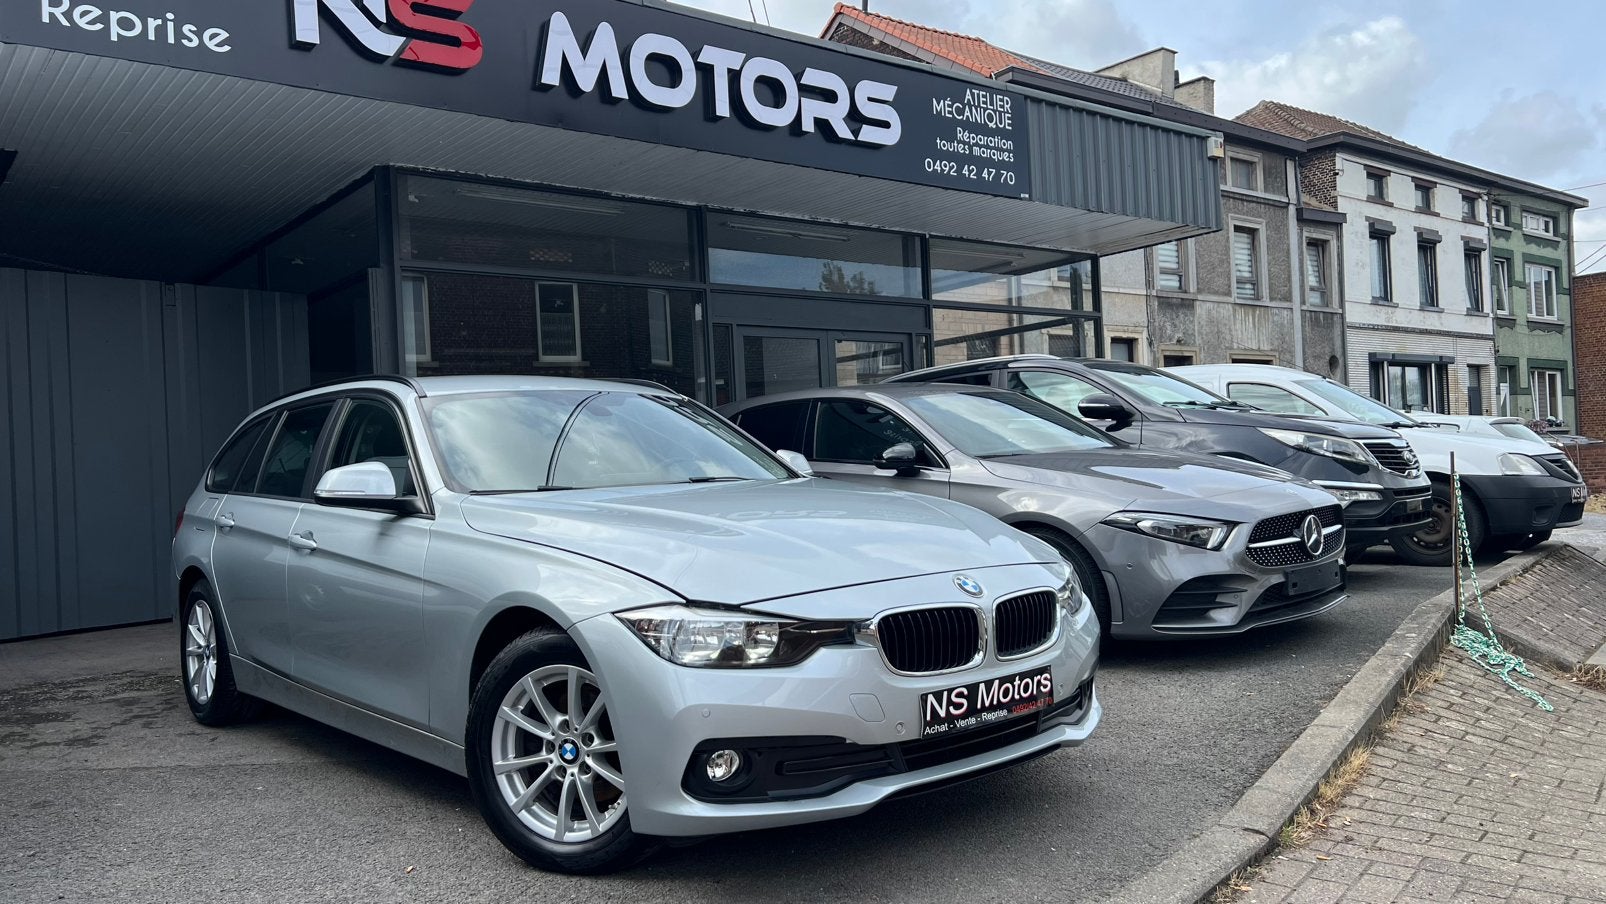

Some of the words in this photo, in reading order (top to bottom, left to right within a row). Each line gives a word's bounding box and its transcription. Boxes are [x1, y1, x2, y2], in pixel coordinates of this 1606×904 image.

[41, 0, 232, 53] Reprise
[541, 11, 902, 146] MOTORS
[932, 98, 1012, 130] MÉCANIQUE
[964, 88, 1012, 113] ATELIER
[936, 137, 970, 154] toutes
[972, 145, 1014, 162] marques
[956, 127, 1014, 150] Réparation
[924, 158, 957, 176] 0492
[962, 164, 977, 179] 42
[982, 167, 996, 181] 47
[1000, 170, 1015, 185] 70
[926, 687, 968, 721] NS
[977, 673, 1051, 709] Motors
[924, 722, 949, 735] Achat
[954, 716, 976, 728] Vente
[981, 708, 1008, 722] Reprise
